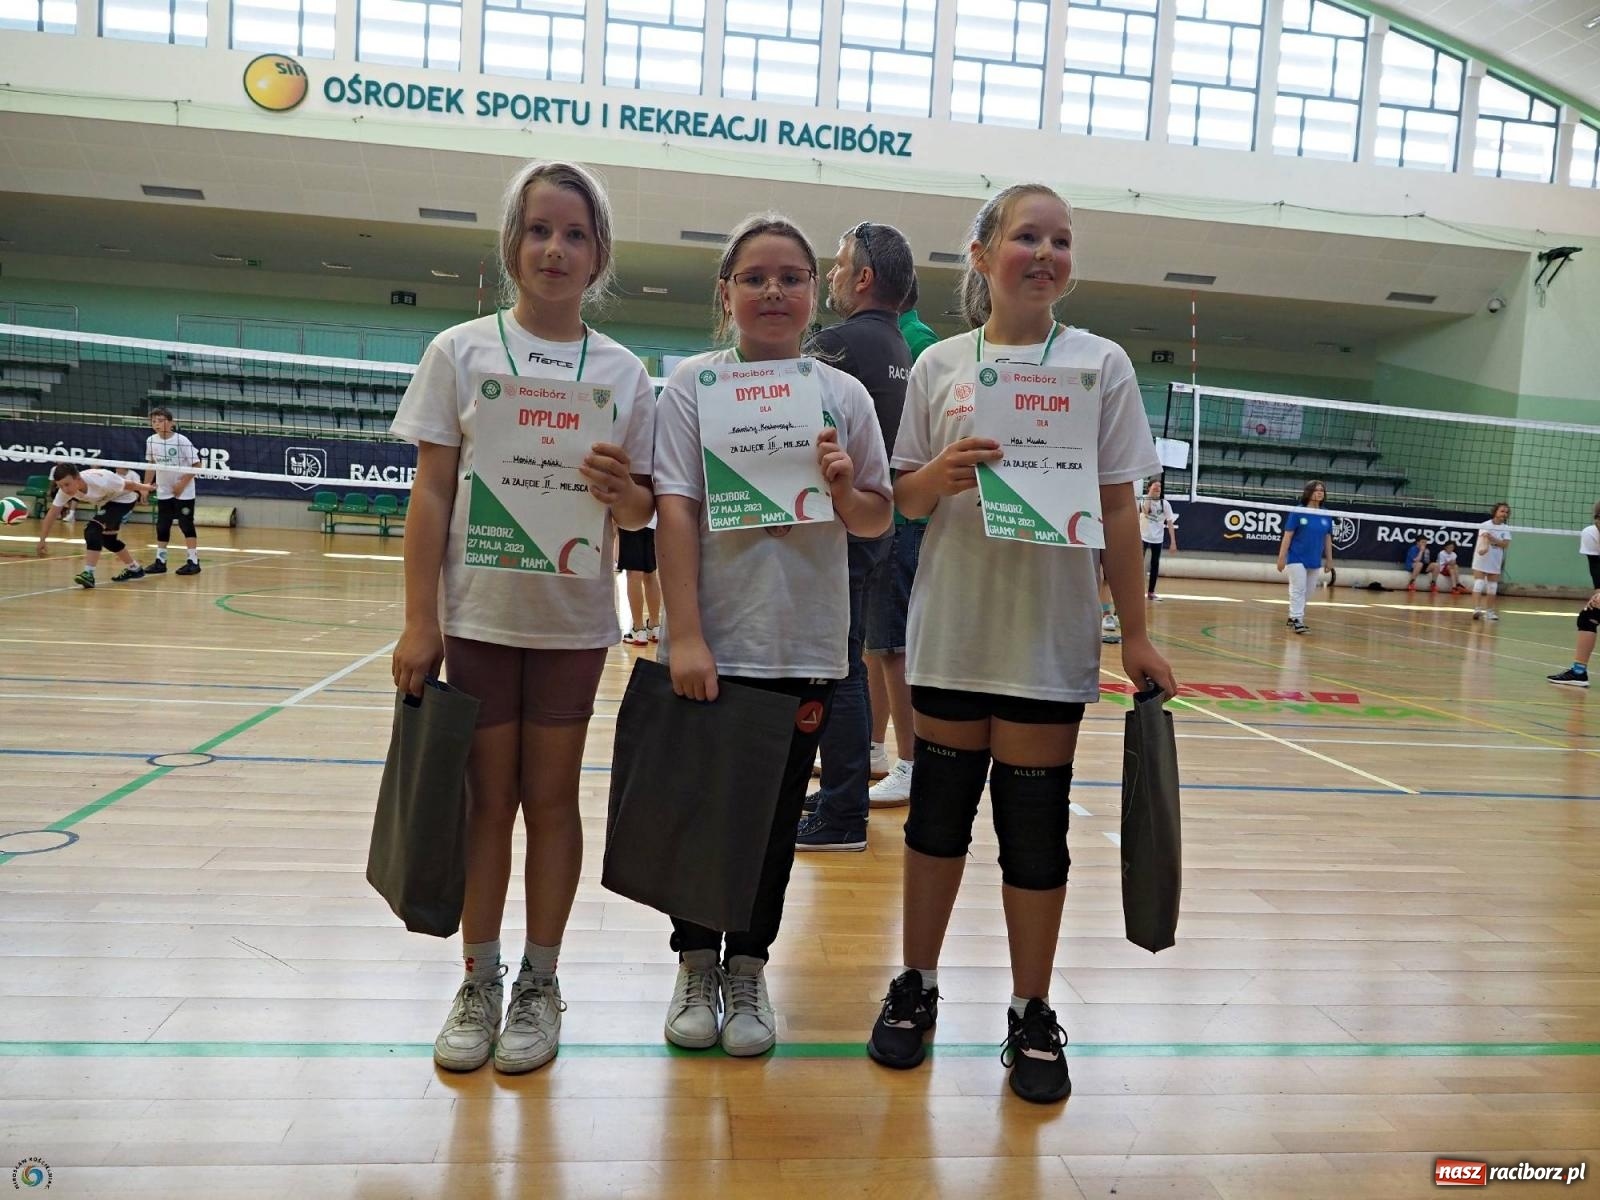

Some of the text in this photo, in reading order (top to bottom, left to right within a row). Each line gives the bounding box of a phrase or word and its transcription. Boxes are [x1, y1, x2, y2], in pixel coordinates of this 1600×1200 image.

[324, 74, 912, 157] OŚRODEK SPORTU I REKREACJI RACIBÓRZ
[732, 368, 775, 380] Racibórz
[1014, 373, 1057, 384] Racibórz
[519, 387, 567, 400] Racibórz
[736, 384, 790, 402] DYPLOM
[1015, 394, 1070, 412] DYPLOM
[946, 405, 974, 416] Racibó
[519, 408, 580, 430] DYPLOM
[541, 436, 555, 445] DLA
[783, 440, 810, 449] MIEJSCA
[1056, 462, 1083, 470] MIEJSCA
[501, 477, 511, 485] ZA
[560, 482, 589, 492] MIEJSCA
[711, 503, 762, 514] 27 MAJA 2023
[712, 516, 740, 527] GRAMY
[761, 512, 786, 523] MAMY
[987, 513, 1036, 528] 27 MAJA 2023
[1224, 510, 1282, 533] OSiR
[989, 525, 1015, 536] GRAMY
[1035, 531, 1059, 541] MAMY
[1245, 532, 1282, 542] RACIBÓRZ
[467, 538, 525, 553] 27 MAJA 2023
[466, 552, 498, 565] GRAMY
[521, 557, 549, 570] MAMY
[926, 744, 957, 758] ALLSIX
[1014, 768, 1046, 777] ALLSIX
